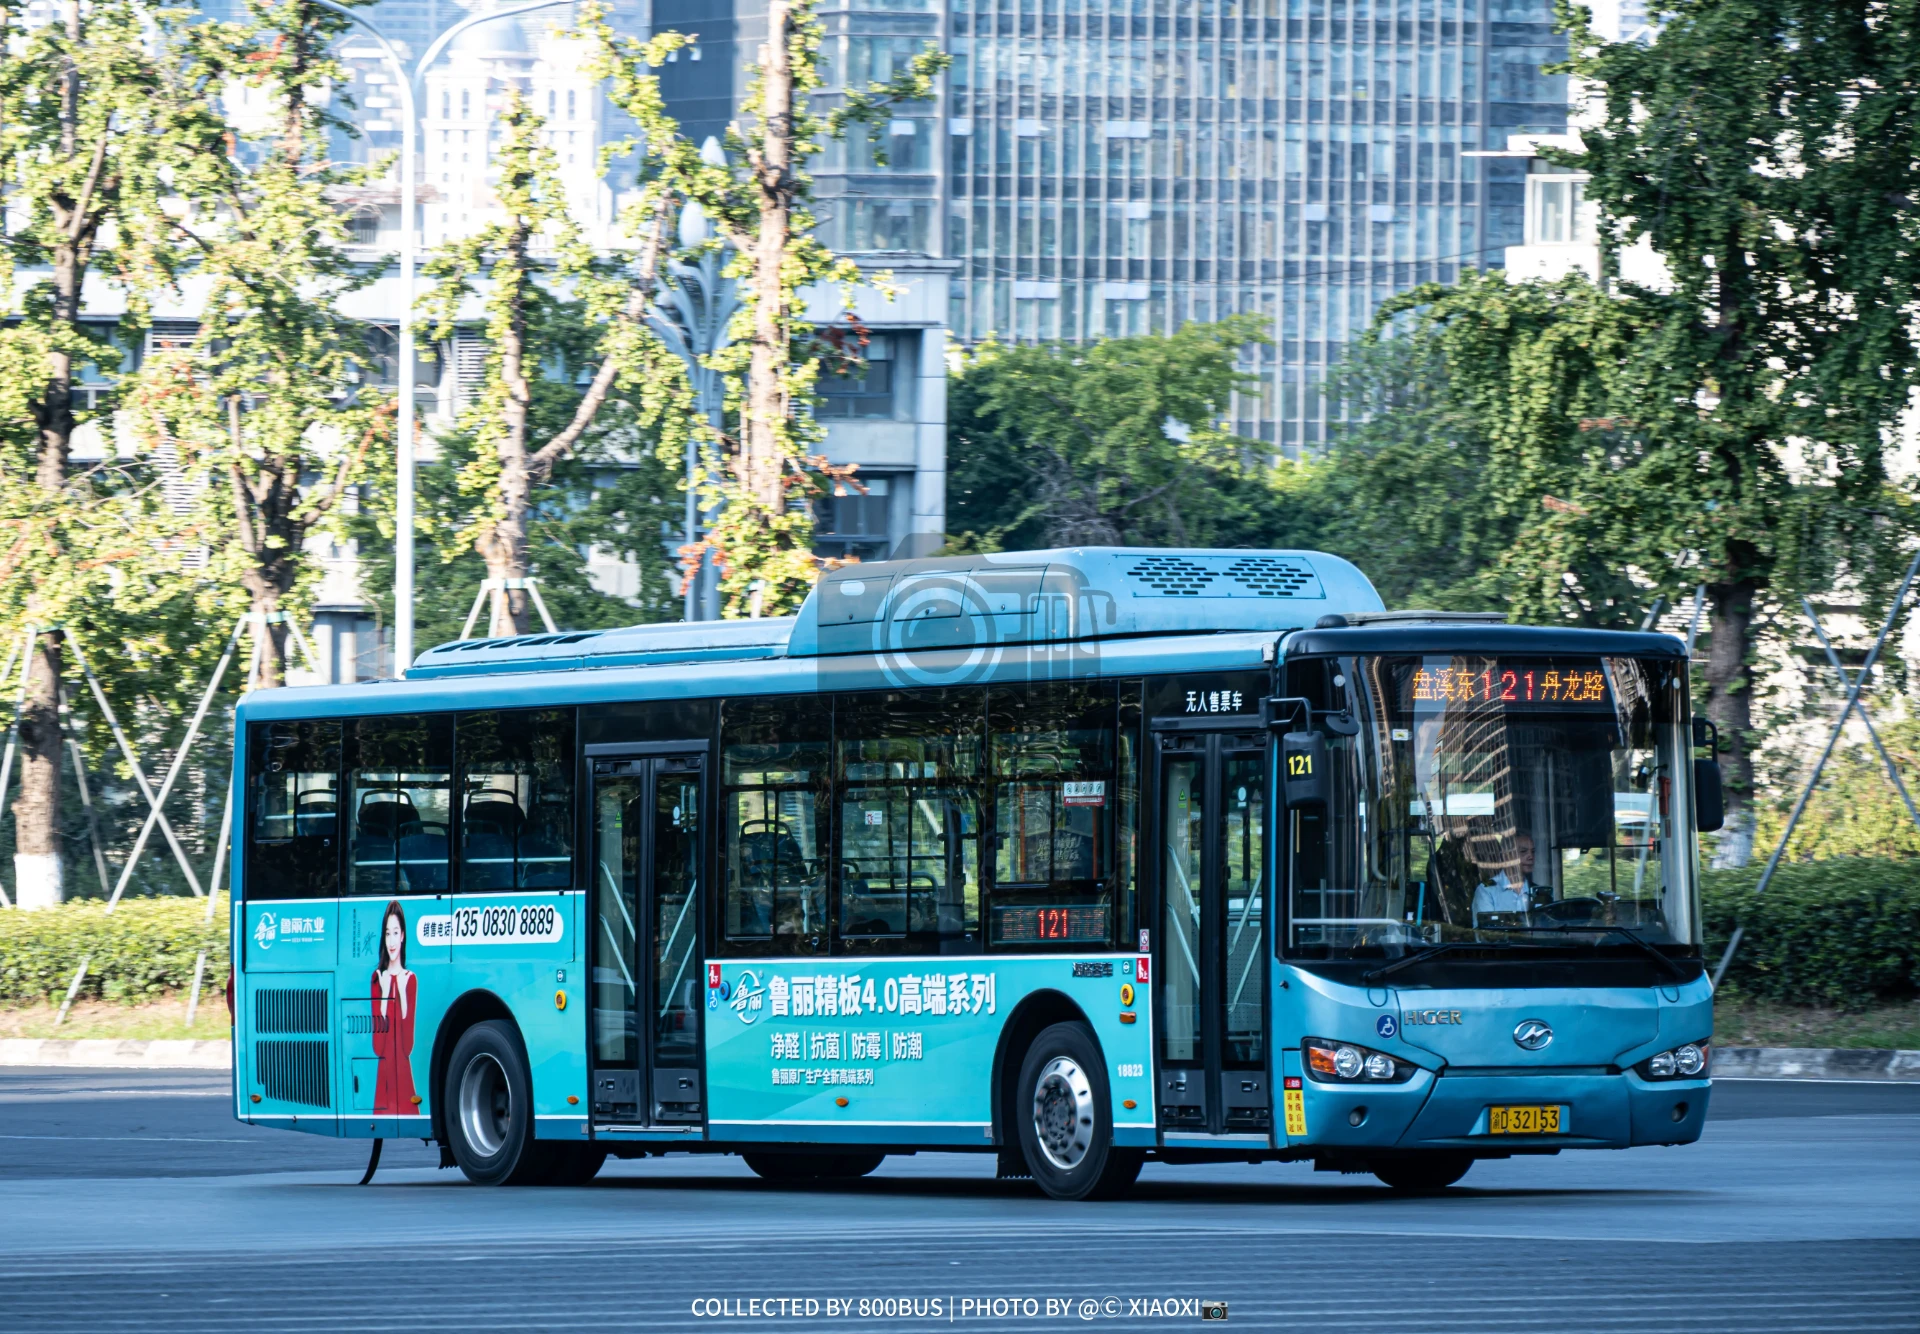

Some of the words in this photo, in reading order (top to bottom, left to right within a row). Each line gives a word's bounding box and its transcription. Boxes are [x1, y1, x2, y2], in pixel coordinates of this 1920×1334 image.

[1186, 690, 1243, 713] 无人售票车
[1288, 754, 1313, 776] 121
[280, 917, 325, 934] 鲁丽木业
[455, 910, 479, 937] 135
[482, 908, 516, 936] 0830
[519, 907, 555, 935] 8889
[1038, 909, 1068, 938] 121
[768, 973, 997, 1017] 鲁丽精板4.0高端系列
[1403, 1010, 1463, 1026] HIGER
[770, 1032, 800, 1060] 净醛
[810, 1032, 841, 1060] 抗菌
[851, 1032, 881, 1060] 防霉
[892, 1032, 923, 1060] 防潮
[771, 1068, 874, 1085] 鲁丽原厂生产全新高端系列
[1117, 1064, 1144, 1078] 18823
